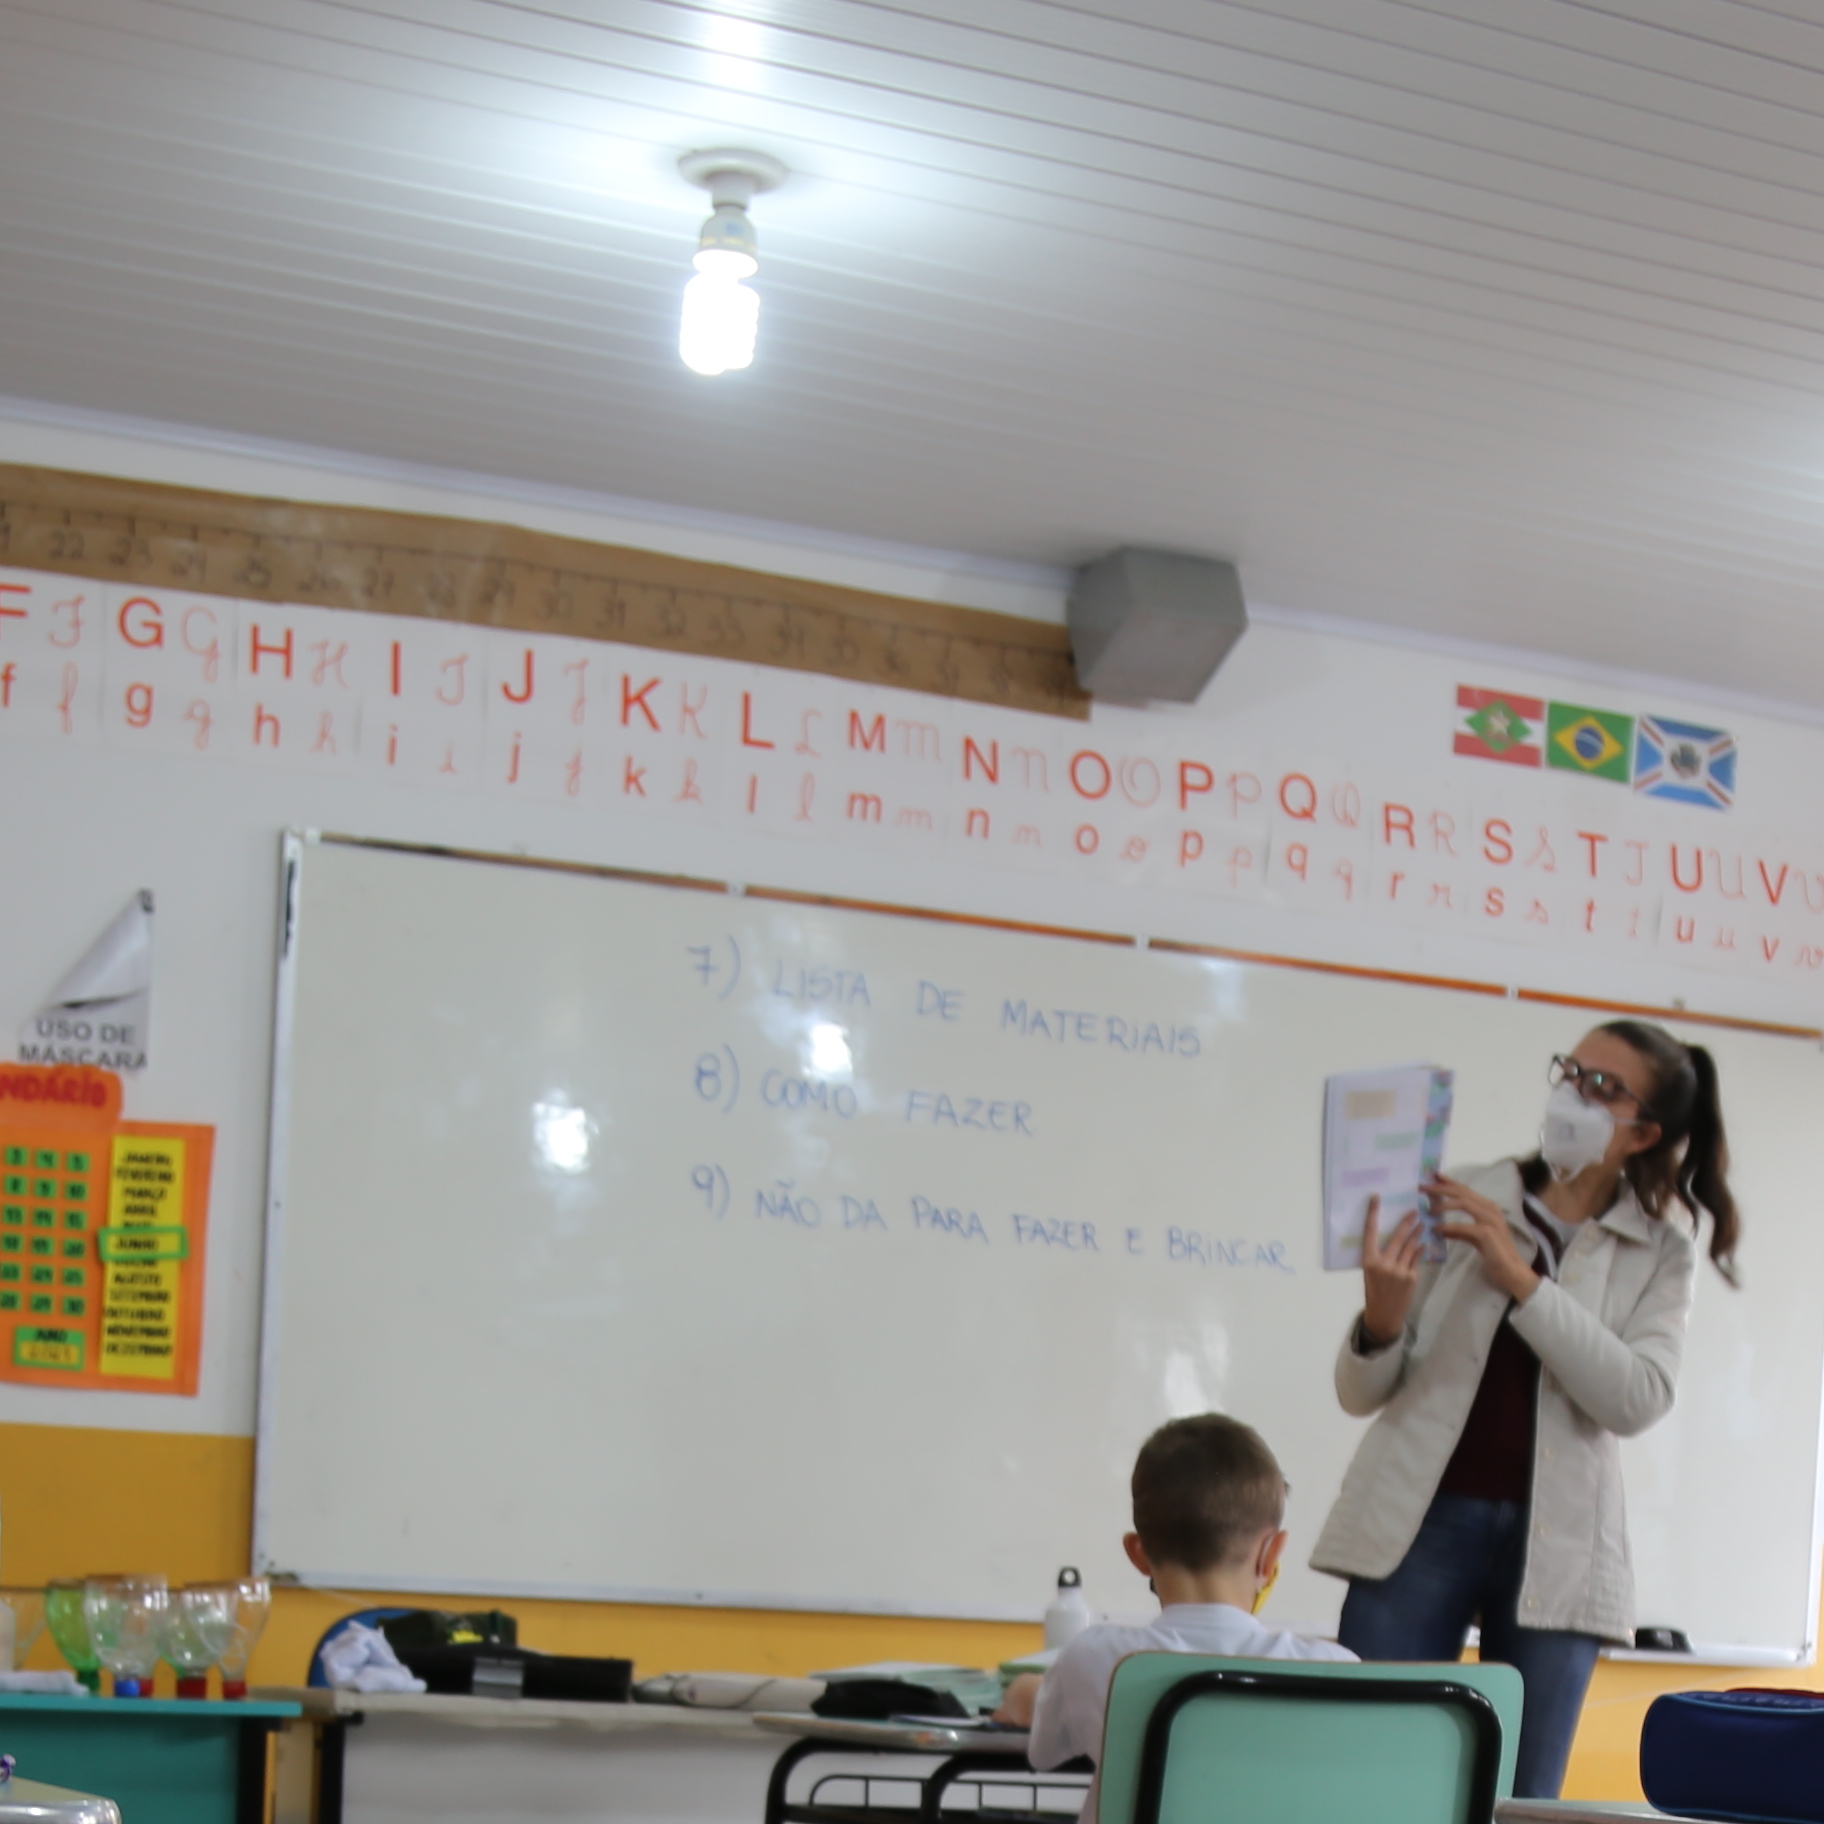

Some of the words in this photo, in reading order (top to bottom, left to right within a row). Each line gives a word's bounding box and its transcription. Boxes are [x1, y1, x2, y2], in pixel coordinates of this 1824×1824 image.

[117, 597, 164, 650] G
[250, 623, 294, 681] H
[500, 648, 534, 705] J
[620, 672, 663, 733] K
[741, 690, 777, 750] L
[848, 709, 886, 754] M
[962, 735, 1000, 785] N
[1179, 759, 1216, 811] P
[1278, 772, 1318, 824] Q
[1384, 802, 1416, 850] R
[1577, 830, 1608, 879] T
[1668, 842, 1704, 894] U
[126, 681, 154, 729] g
[254, 703, 281, 749] h
[387, 723, 399, 767] i
[507, 731, 521, 785] j
[625, 755, 647, 798] k
[847, 791, 883, 824] m
[965, 806, 990, 841] n
[1180, 828, 1205, 868] p
[1287, 842, 1308, 882] q
[1389, 870, 1406, 900] r
[1585, 901, 1597, 934] t
[1677, 914, 1695, 944] u
[37, 1019, 93, 1041] USO
[100, 1022, 136, 1045] DE
[772, 960, 871, 1007] LISTA
[918, 980, 964, 1021] DE
[1001, 998, 1202, 1059] MATERIAIS
[761, 1068, 858, 1120] COMO
[905, 1090, 1033, 1136] FAZER
[755, 1179, 822, 1229] NÃO
[912, 1195, 989, 1245] PARA
[1012, 1212, 1100, 1252] FAZER
[1168, 1224, 1296, 1275] BRINCAR
